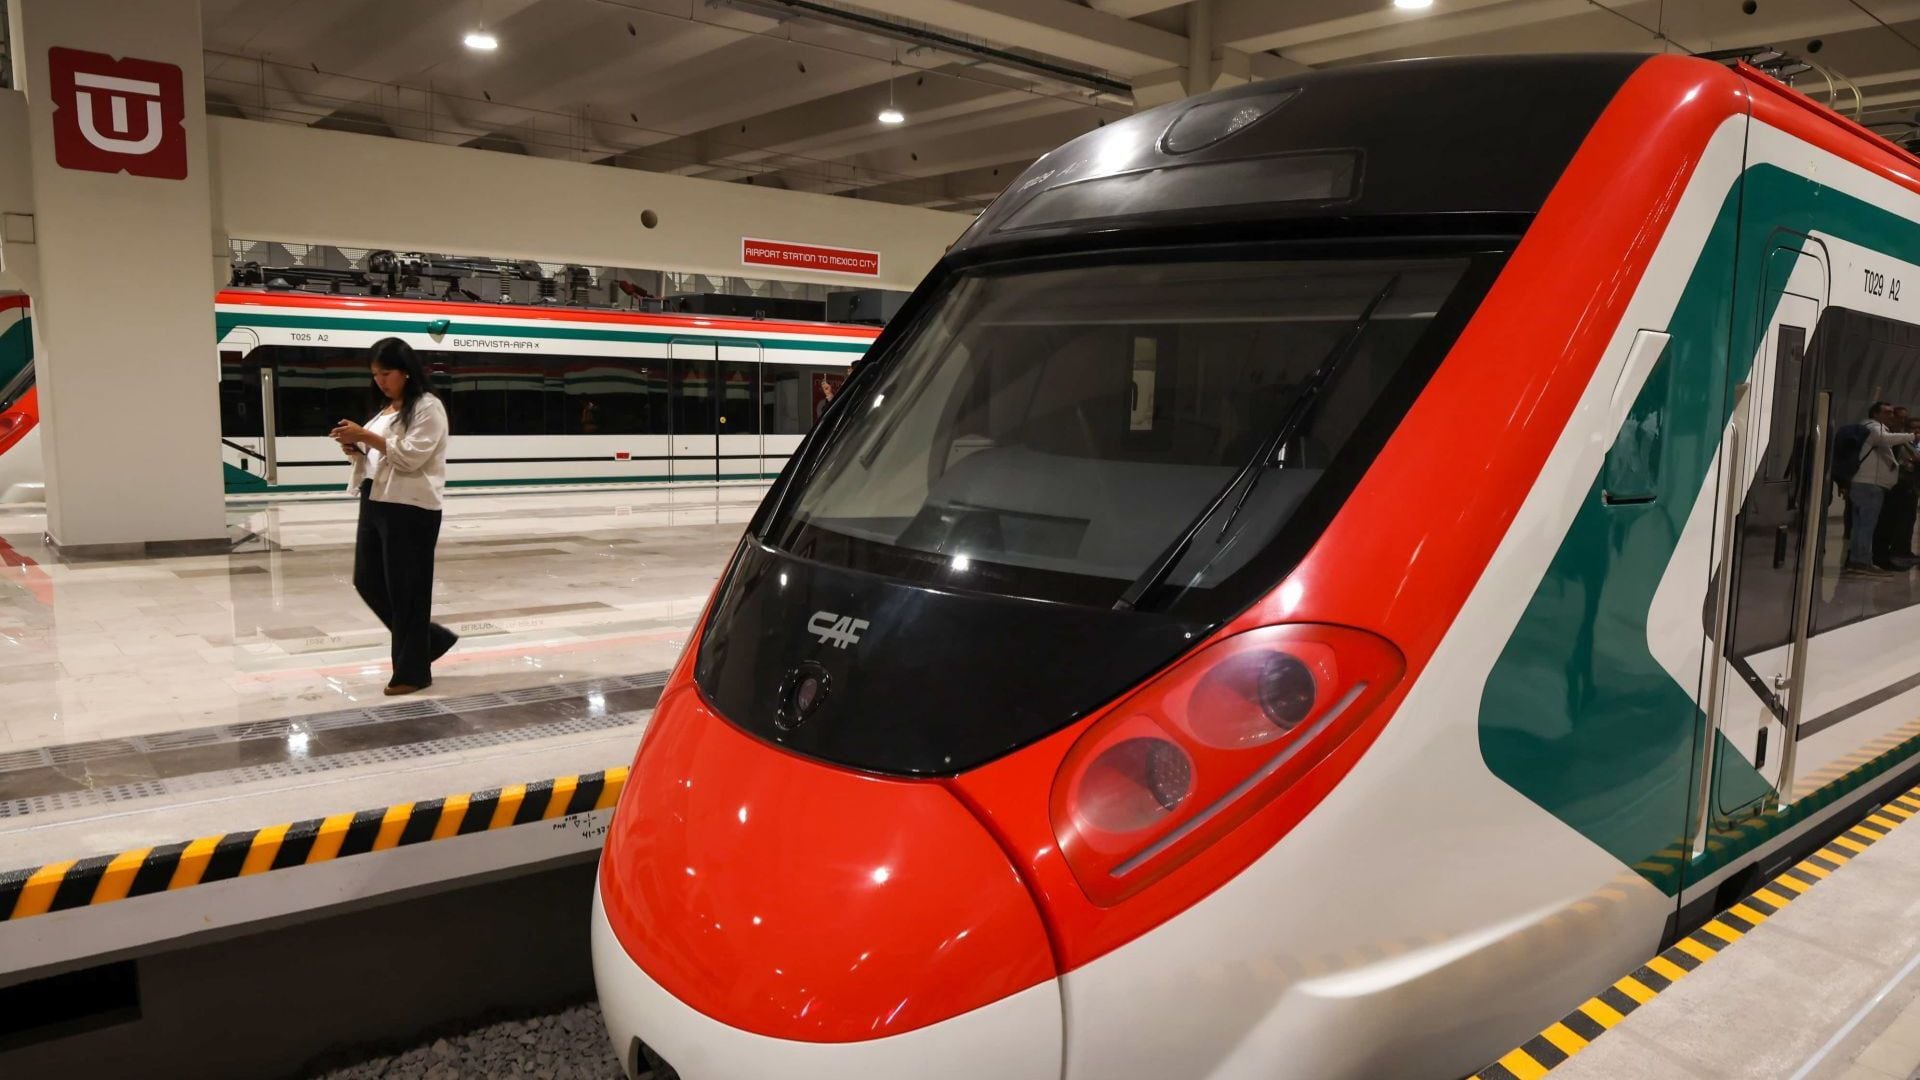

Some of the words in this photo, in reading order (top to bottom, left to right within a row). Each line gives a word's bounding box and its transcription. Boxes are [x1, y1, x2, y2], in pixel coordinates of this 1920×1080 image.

[745, 247, 781, 259] AIRPORT
[782, 251, 816, 263] STATION
[818, 254, 828, 264] TO
[829, 256, 858, 267] MEXICO
[859, 259, 877, 269] CITY
[1864, 269, 1884, 297] T029
[1888, 277, 1901, 302] A2
[291, 333, 312, 342] T025
[318, 334, 329, 342] A2
[807, 610, 870, 650] CAF
